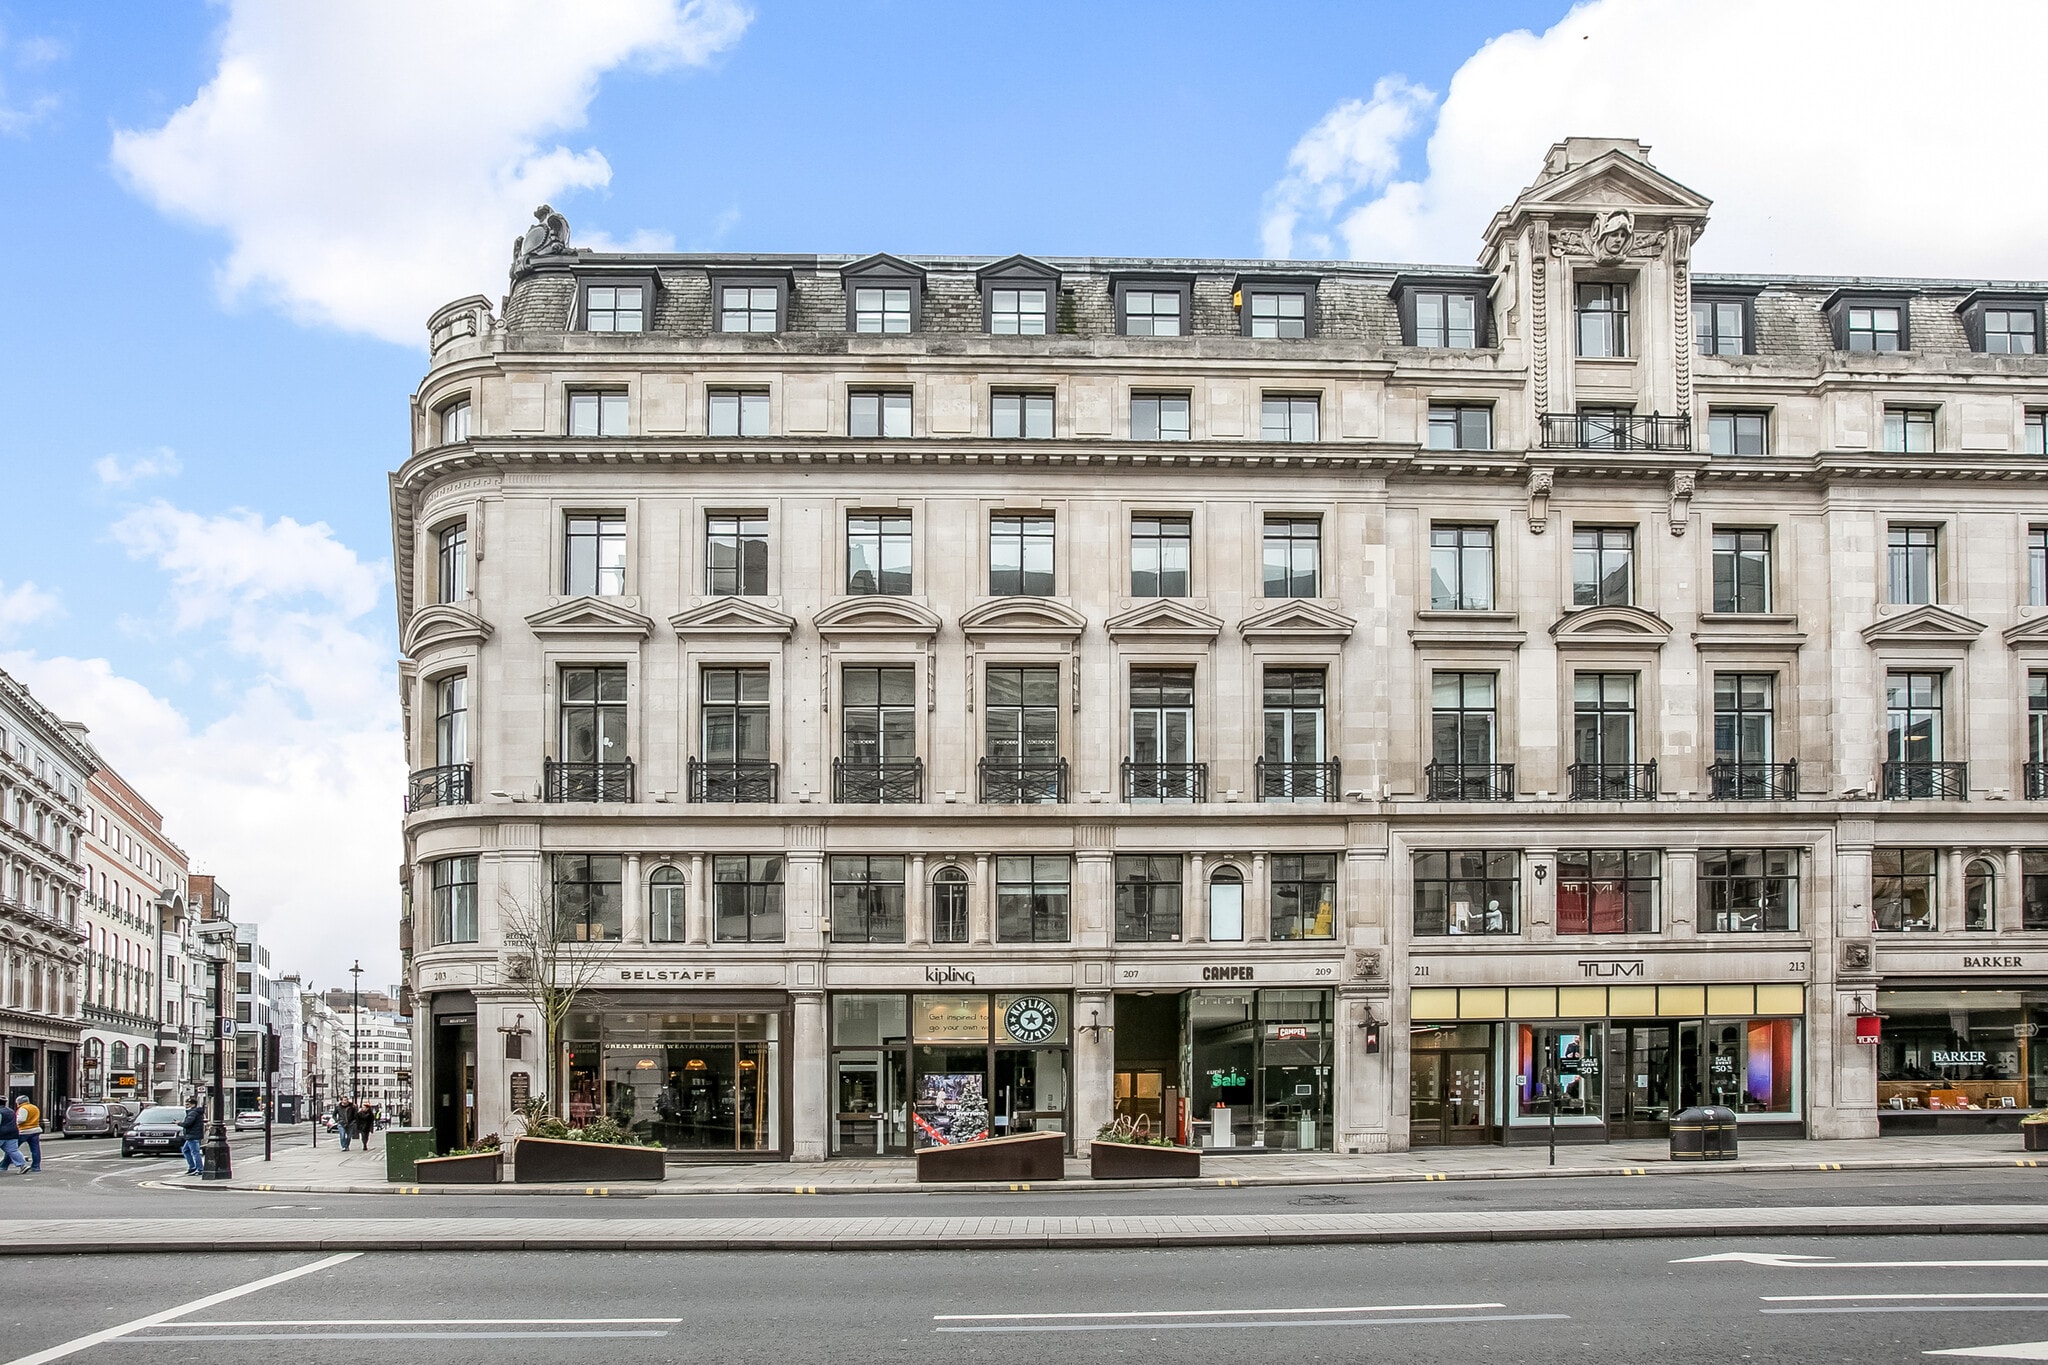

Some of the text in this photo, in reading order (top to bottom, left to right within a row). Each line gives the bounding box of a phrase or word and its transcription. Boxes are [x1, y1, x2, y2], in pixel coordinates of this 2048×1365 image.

[1788, 962, 1806, 972] 213
[1963, 956, 2023, 968] BARKER
[1202, 966, 1254, 980] CAMPER
[1315, 967, 1332, 976] 209
[1414, 966, 1430, 976] 211
[1578, 960, 1644, 976] TUMI
[434, 971, 447, 981] 203
[621, 971, 716, 980] BELSTAFF
[925, 965, 975, 985] kipling
[1123, 970, 1139, 978] 207
[1010, 1000, 1052, 1016] KIPLING
[947, 1014, 977, 1022] inspired
[928, 1025, 940, 1033] go
[1010, 1023, 1053, 1040] KIPLING
[1280, 1028, 1306, 1037] CAMPER
[1434, 1031, 1457, 1041] 211
[1857, 1035, 1878, 1044] TUMI
[1932, 1050, 1987, 1062] BARKER
[1212, 1073, 1246, 1087] Sale
